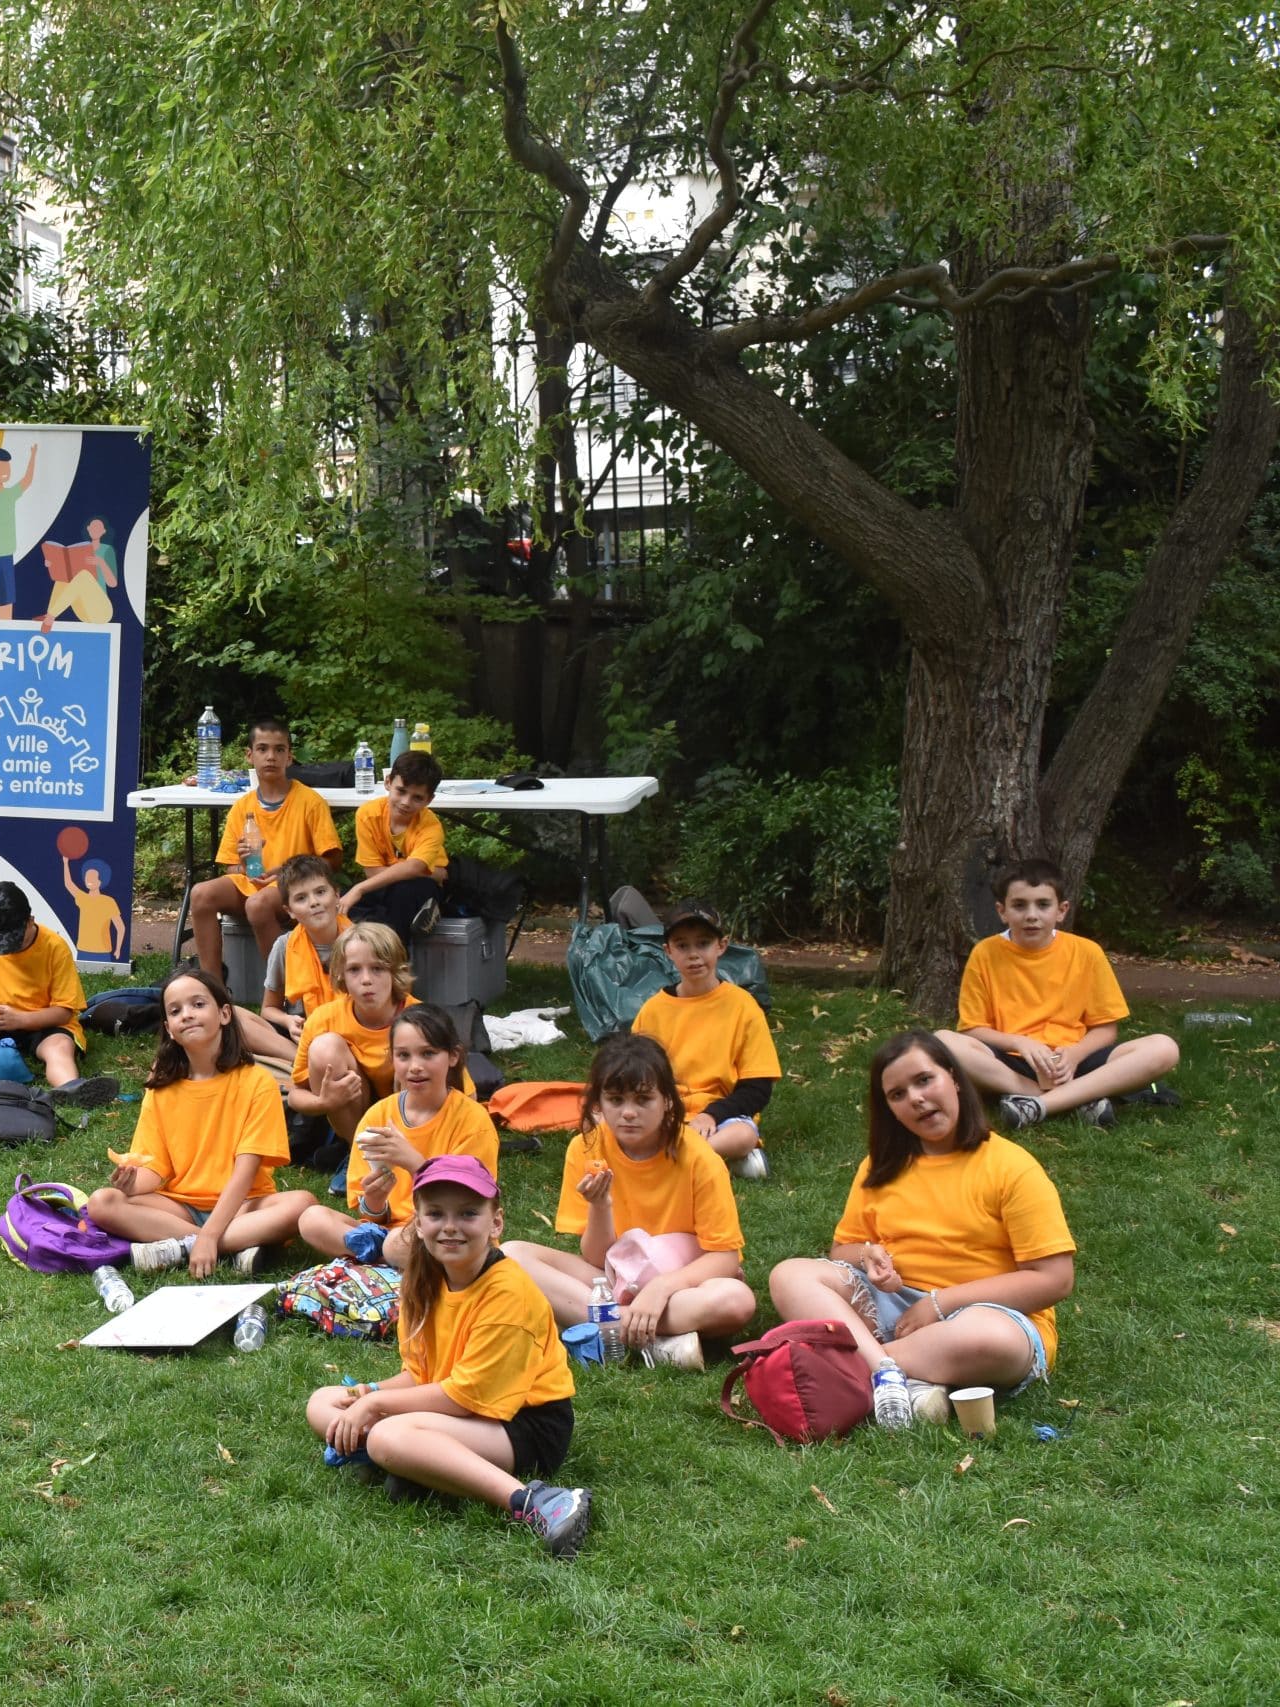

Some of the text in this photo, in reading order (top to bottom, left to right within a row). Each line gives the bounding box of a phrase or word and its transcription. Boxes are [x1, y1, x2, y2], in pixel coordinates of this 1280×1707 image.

[6, 735, 49, 753] Ville
[2, 756, 52, 773] amie
[10, 776, 84, 796] enfants
